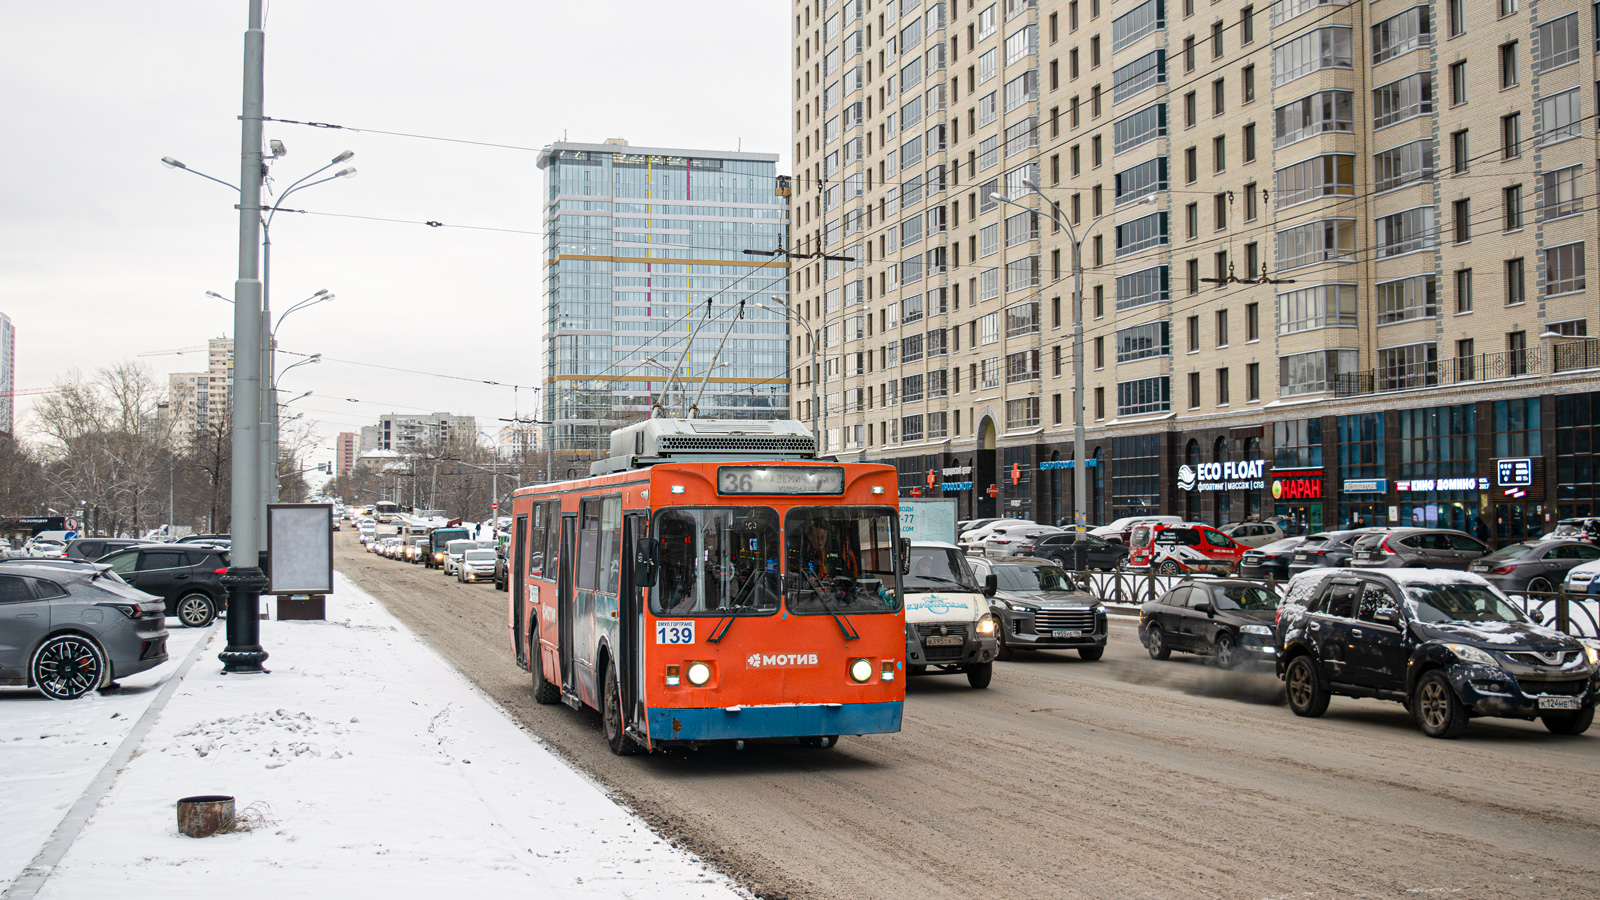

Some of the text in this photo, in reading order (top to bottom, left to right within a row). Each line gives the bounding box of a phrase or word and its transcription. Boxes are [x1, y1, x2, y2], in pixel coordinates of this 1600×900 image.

[1197, 460, 1265, 481] ECO FLOAT
[725, 473, 753, 493] 36
[1228, 481, 1250, 490] массаж
[1253, 480, 1265, 489] спа
[1281, 479, 1322, 499] НАРАН
[1411, 480, 1434, 491] КИНО
[1437, 478, 1476, 491] ДОМИНО
[658, 627, 692, 644] 139
[763, 654, 818, 666] МОТИВ
